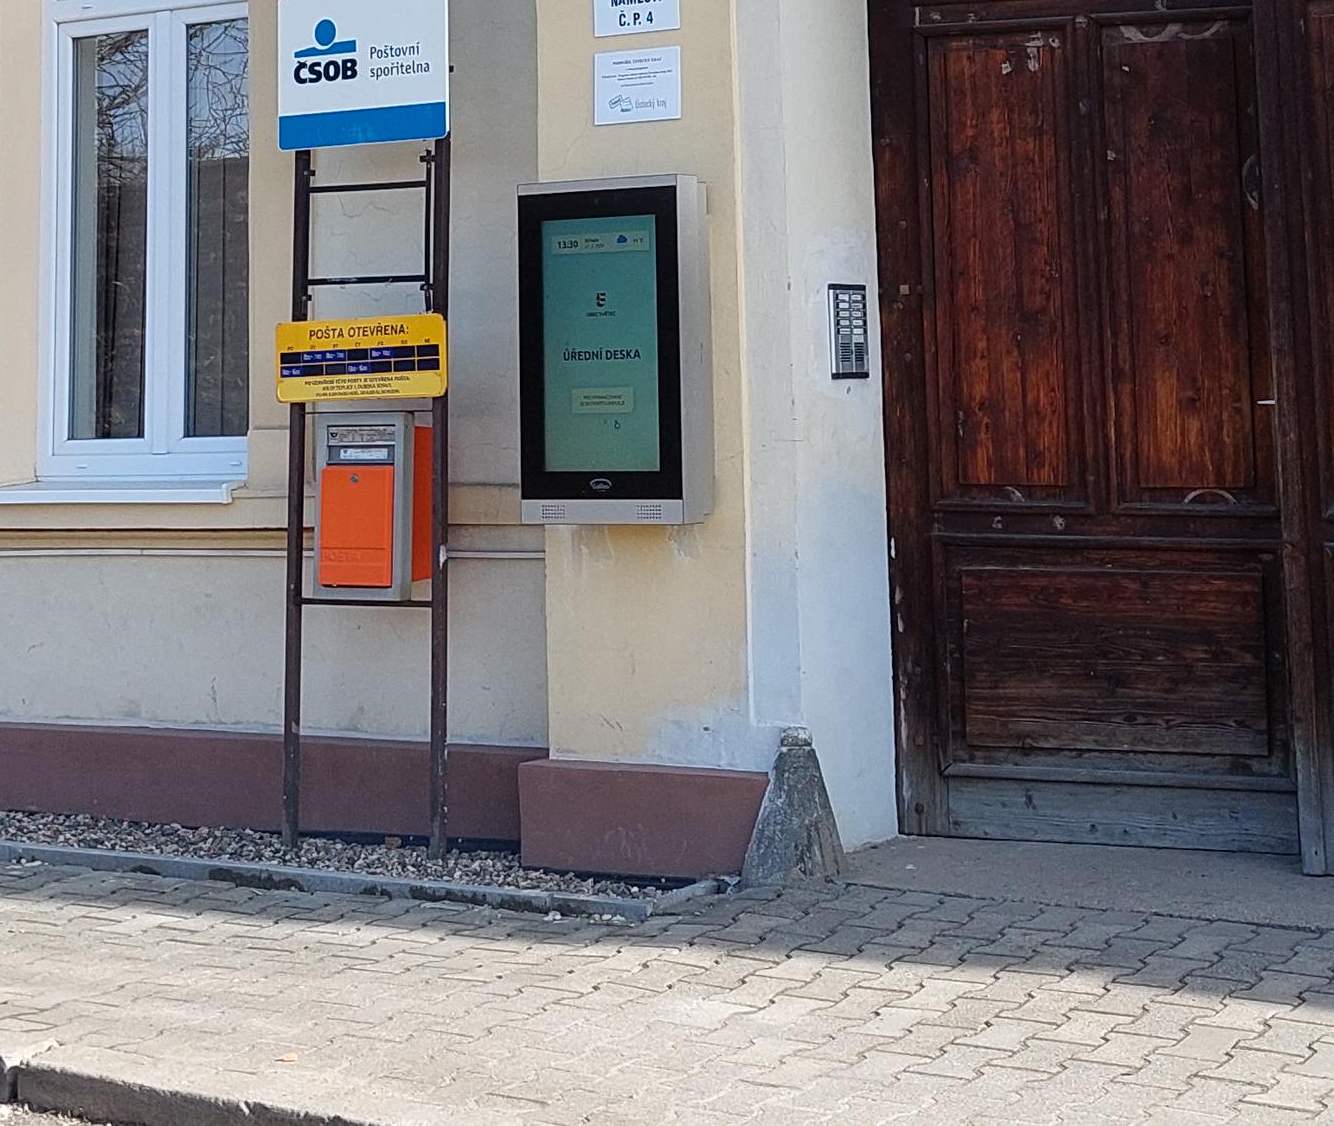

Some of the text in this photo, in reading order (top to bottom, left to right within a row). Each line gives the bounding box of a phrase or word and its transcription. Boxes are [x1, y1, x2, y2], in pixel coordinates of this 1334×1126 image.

[619, 10, 654, 26] Č. P. 4
[370, 42, 420, 60] Poštovní
[294, 58, 358, 84] ČSOB
[370, 60, 430, 79] spořitelna
[309, 323, 409, 340] POŠTA OTEVŘENA:
[563, 347, 642, 361] ÚŘEDNÍ DESKA
